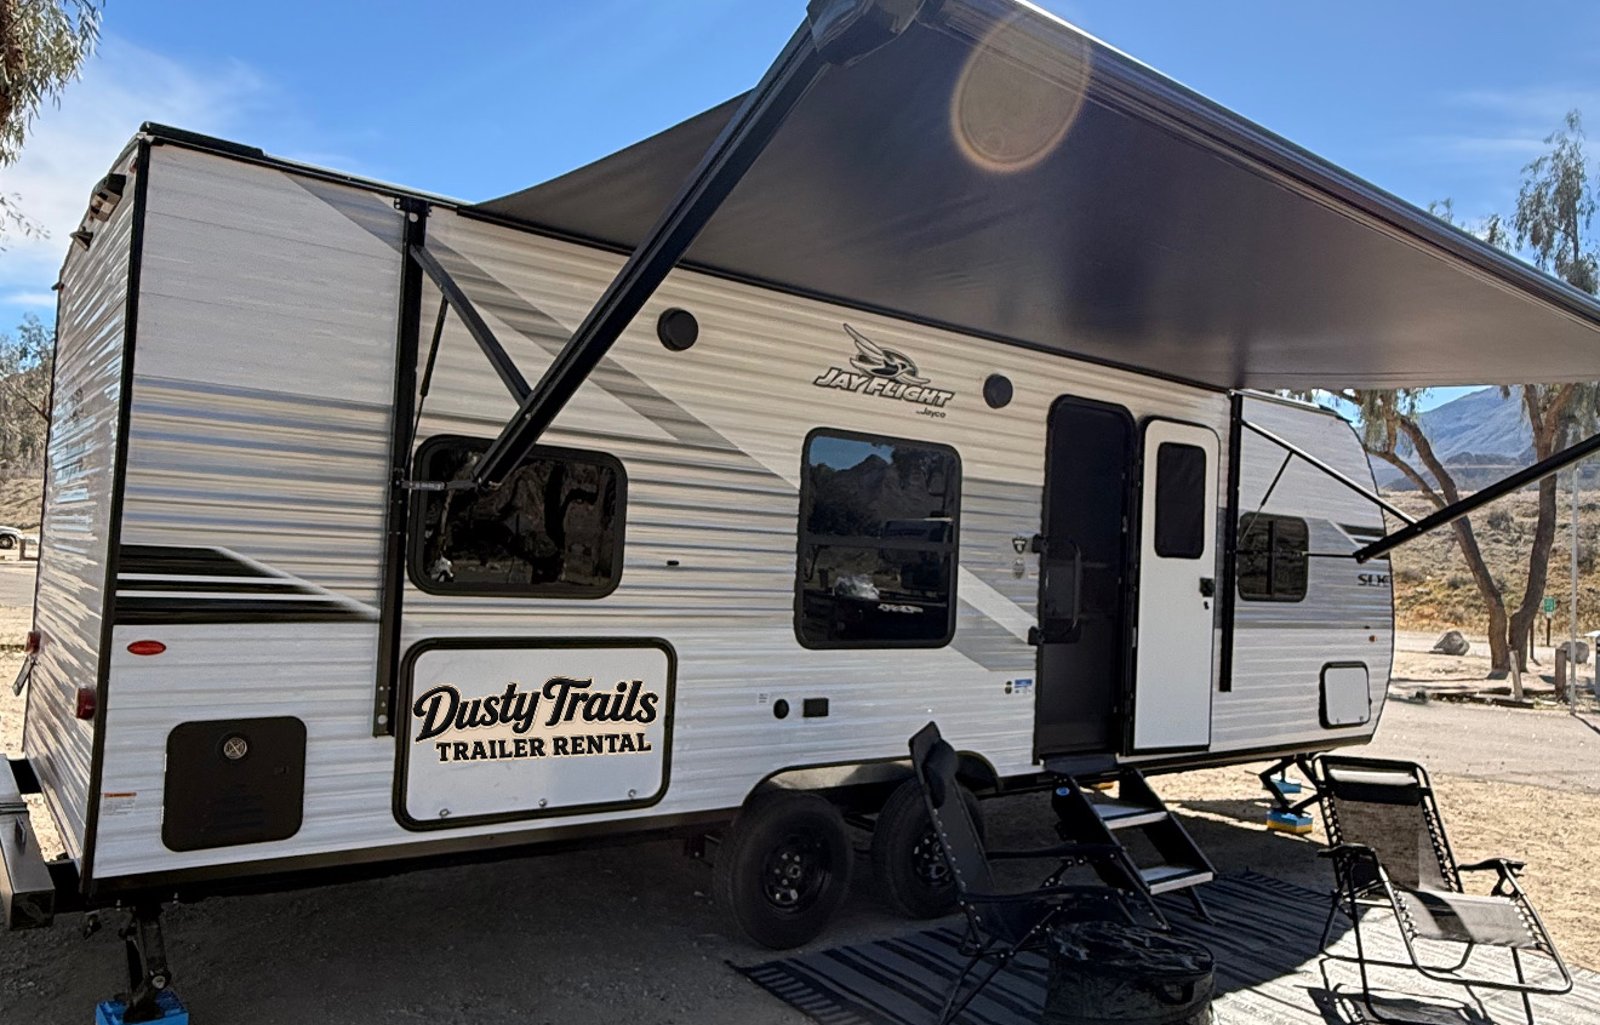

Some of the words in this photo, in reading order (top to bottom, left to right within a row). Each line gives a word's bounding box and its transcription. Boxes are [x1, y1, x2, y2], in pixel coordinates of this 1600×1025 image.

[813, 367, 868, 392] JAY
[861, 376, 956, 408] FLIGHT
[413, 682, 541, 741] Dusty
[542, 677, 659, 726] Trails
[436, 738, 546, 762] TRAILER
[552, 732, 652, 756] RENTAL
